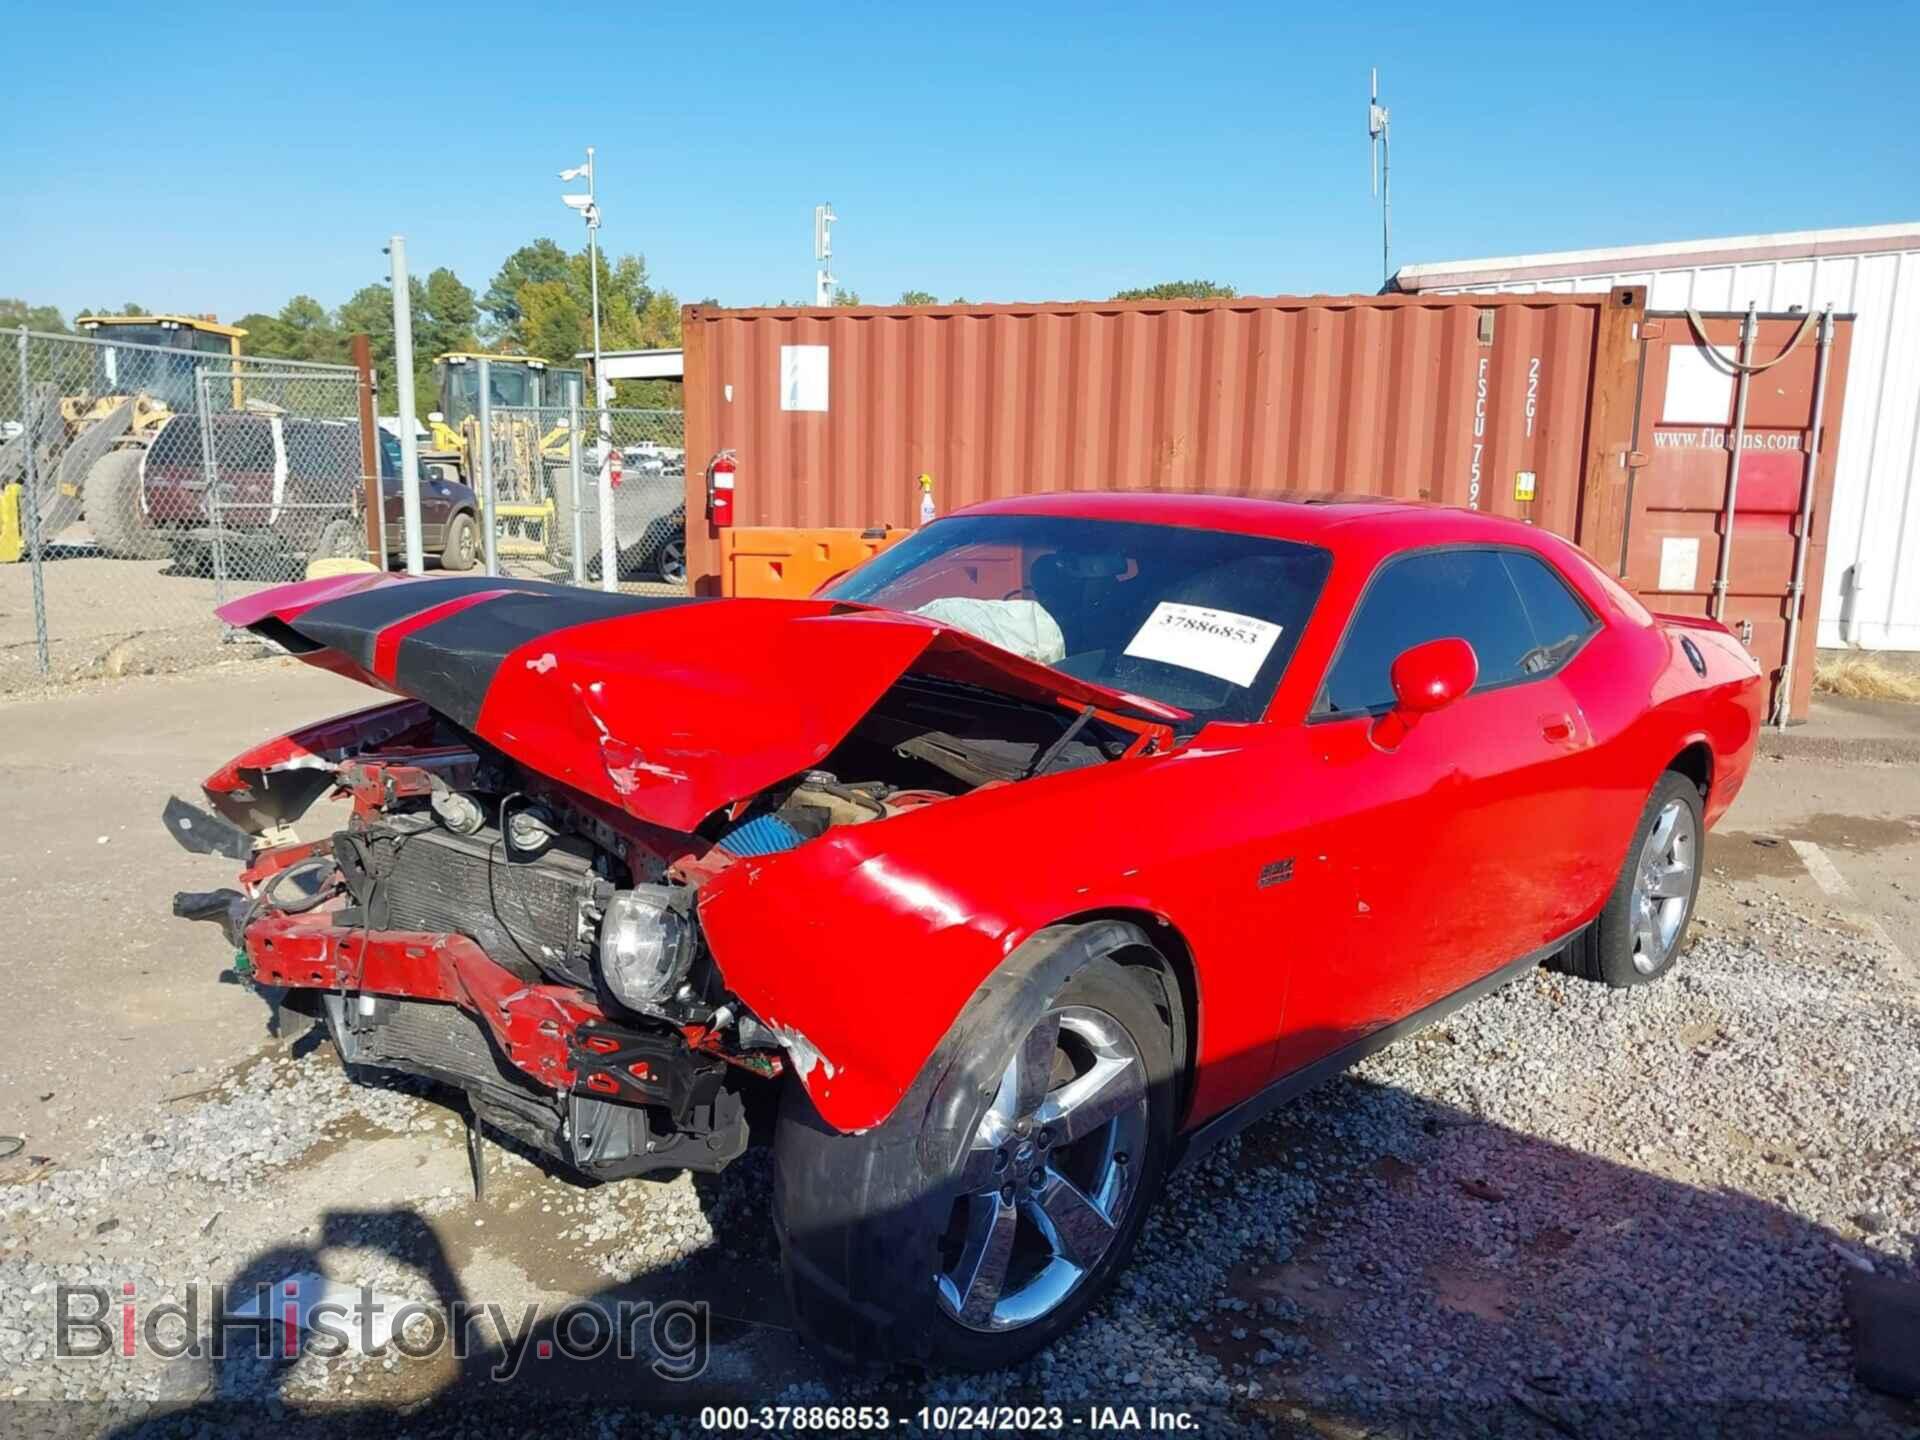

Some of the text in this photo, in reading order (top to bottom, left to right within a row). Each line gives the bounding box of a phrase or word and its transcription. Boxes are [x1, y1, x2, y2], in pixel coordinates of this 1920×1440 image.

[1474, 358, 1488, 437] FSCU
[1525, 358, 1540, 438] 22G1
[1159, 613, 1258, 645] 37886853
